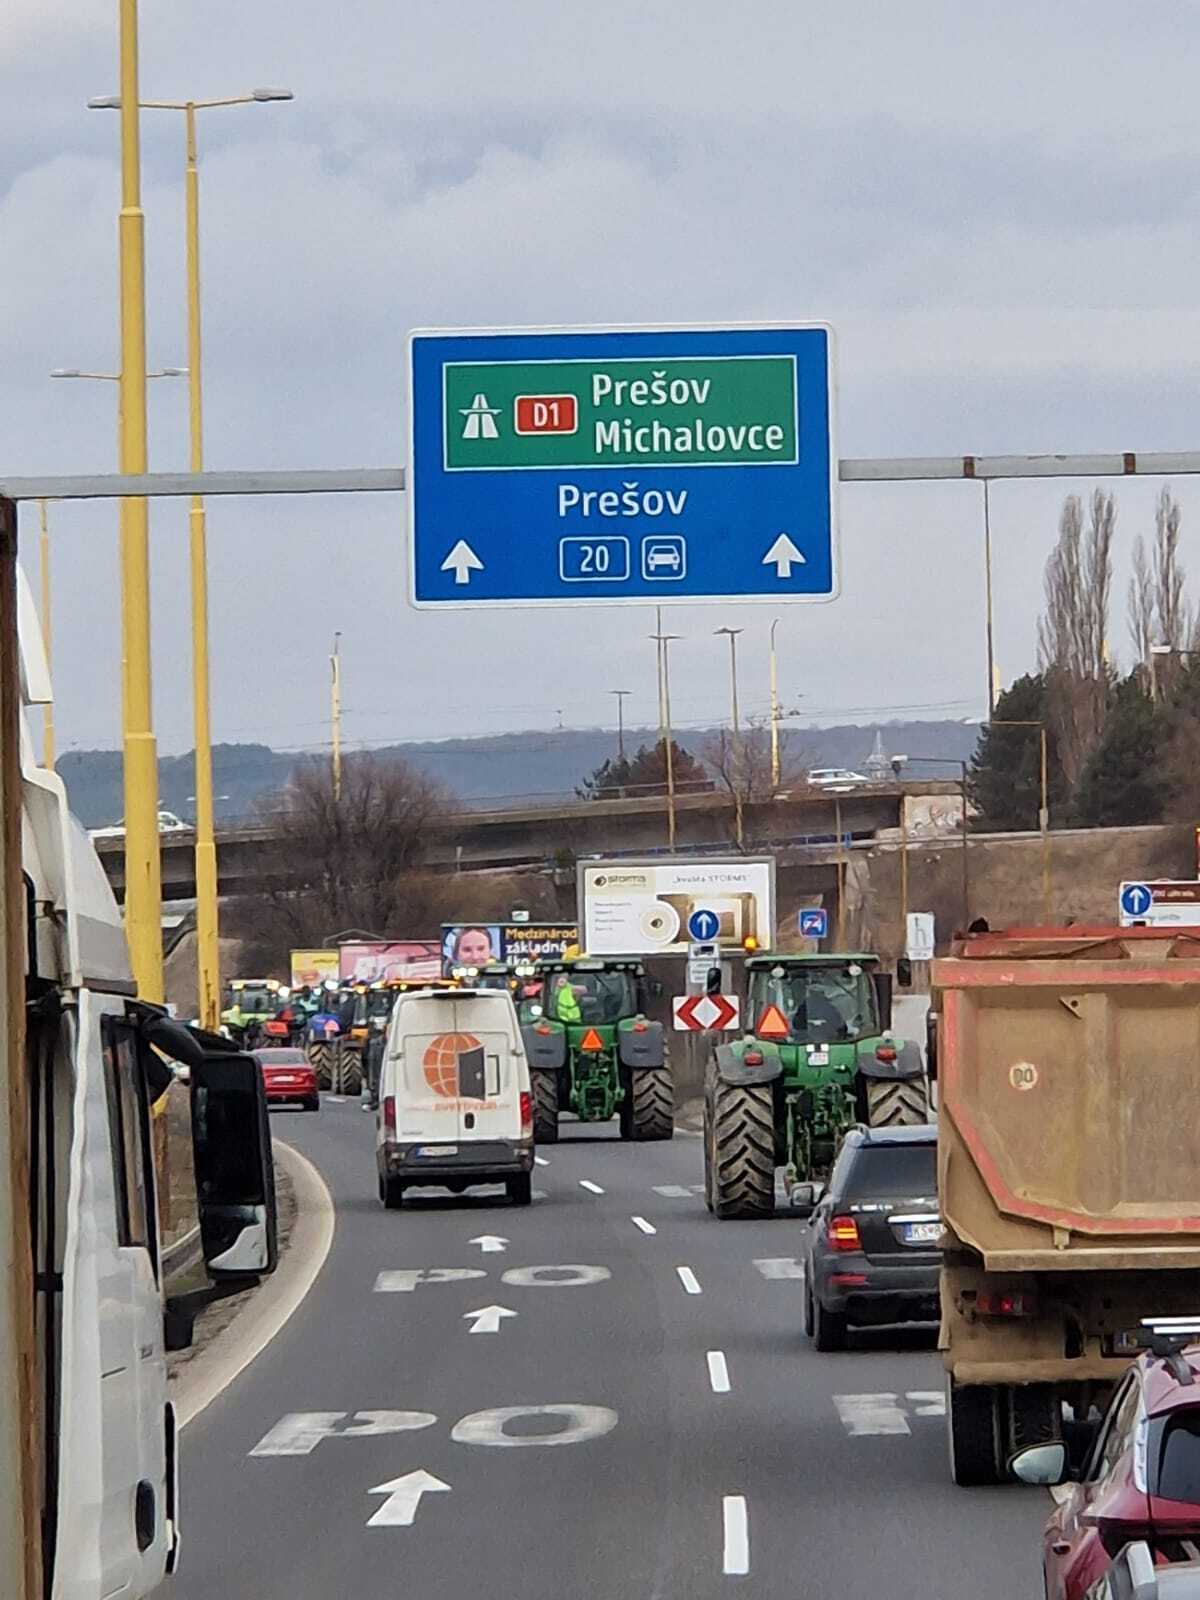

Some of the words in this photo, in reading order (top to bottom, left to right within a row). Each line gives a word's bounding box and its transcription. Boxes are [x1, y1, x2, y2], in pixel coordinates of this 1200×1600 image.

[592, 370, 711, 406] Prešov
[533, 402, 560, 428] D1
[595, 418, 784, 454] Michalovce
[559, 481, 687, 517] Prešov
[580, 545, 609, 572] 20
[374, 1264, 611, 1293] PO
[248, 1403, 619, 1457] PO
